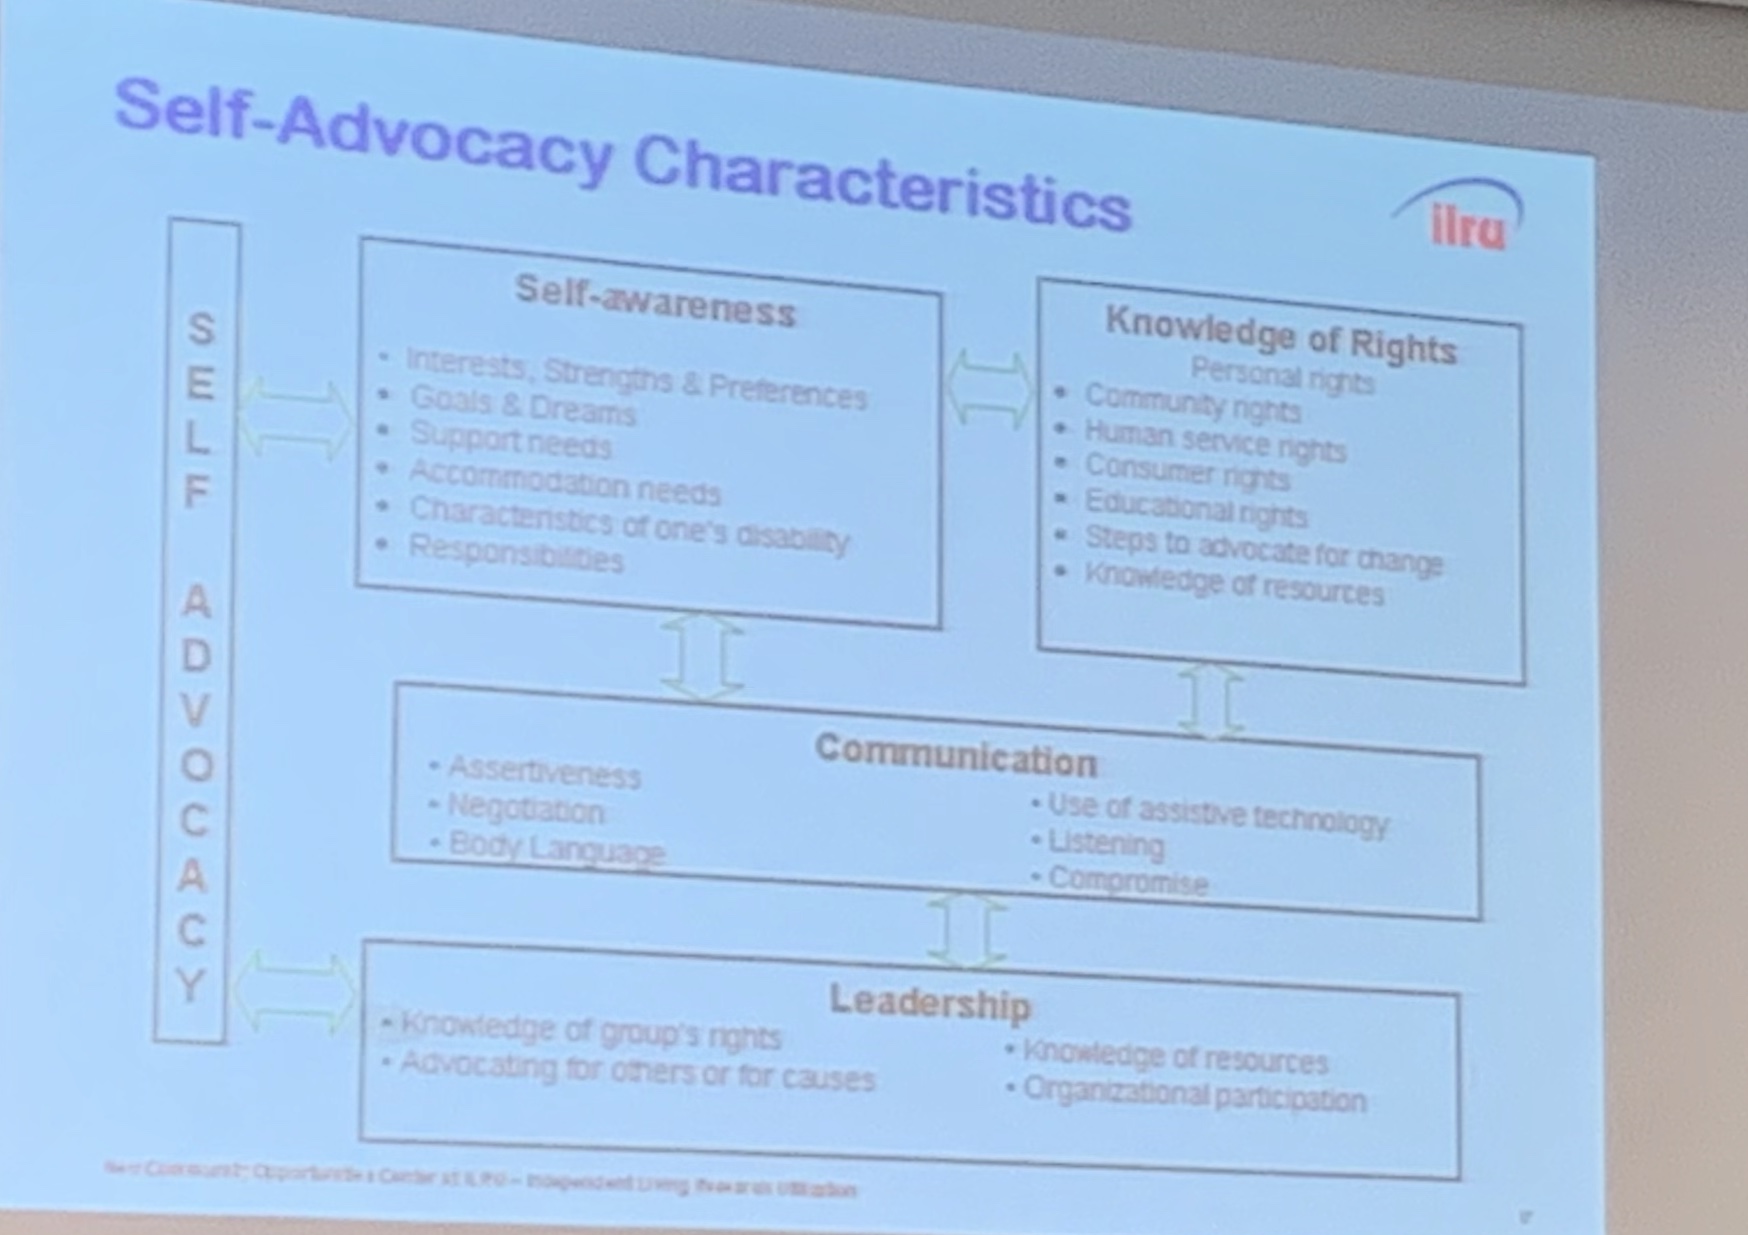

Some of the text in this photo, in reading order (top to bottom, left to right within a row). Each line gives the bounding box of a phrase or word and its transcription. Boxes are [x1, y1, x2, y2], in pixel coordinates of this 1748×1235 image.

[115, 75, 1133, 233] Self-Advocacy Characteristics
[515, 273, 797, 328] Self-awareness
[1106, 304, 1458, 367] Knowledge of Rights
[543, 357, 674, 396] Strengths
[682, 370, 702, 396] &
[709, 372, 868, 411] Preferences
[1191, 356, 1376, 397] Personal rights
[410, 383, 636, 427] Goals & Dreams
[1085, 382, 1302, 426] Community rights
[411, 418, 612, 460] Support needs
[1085, 417, 1348, 466] Human service rights
[410, 457, 722, 506] Accommodation needs
[1085, 451, 1292, 494] Consumer rights
[410, 494, 851, 559] Characteristics of one's disability
[1085, 487, 1309, 532] Educational rights
[409, 531, 625, 574] Responsibilities
[1085, 523, 1445, 581] Steps to advocate for change
[1085, 560, 1385, 606] Knowledge of resources
[448, 755, 642, 790] Assertiveness
[815, 731, 1097, 779] Communication
[448, 792, 604, 827] Negotiation
[1049, 792, 1391, 842] Use of assistive technology
[449, 829, 666, 873] Body Language
[1049, 828, 1165, 864] Listening
[1049, 864, 1209, 899] Compromise
[830, 982, 1031, 1028] Leadership
[402, 1008, 782, 1055] Knowledge of group's rights
[402, 1049, 877, 1093] Advocating for others or for causes
[1023, 1038, 1329, 1077] Knowledge of resources
[1023, 1073, 1367, 1115] Organizational participation
